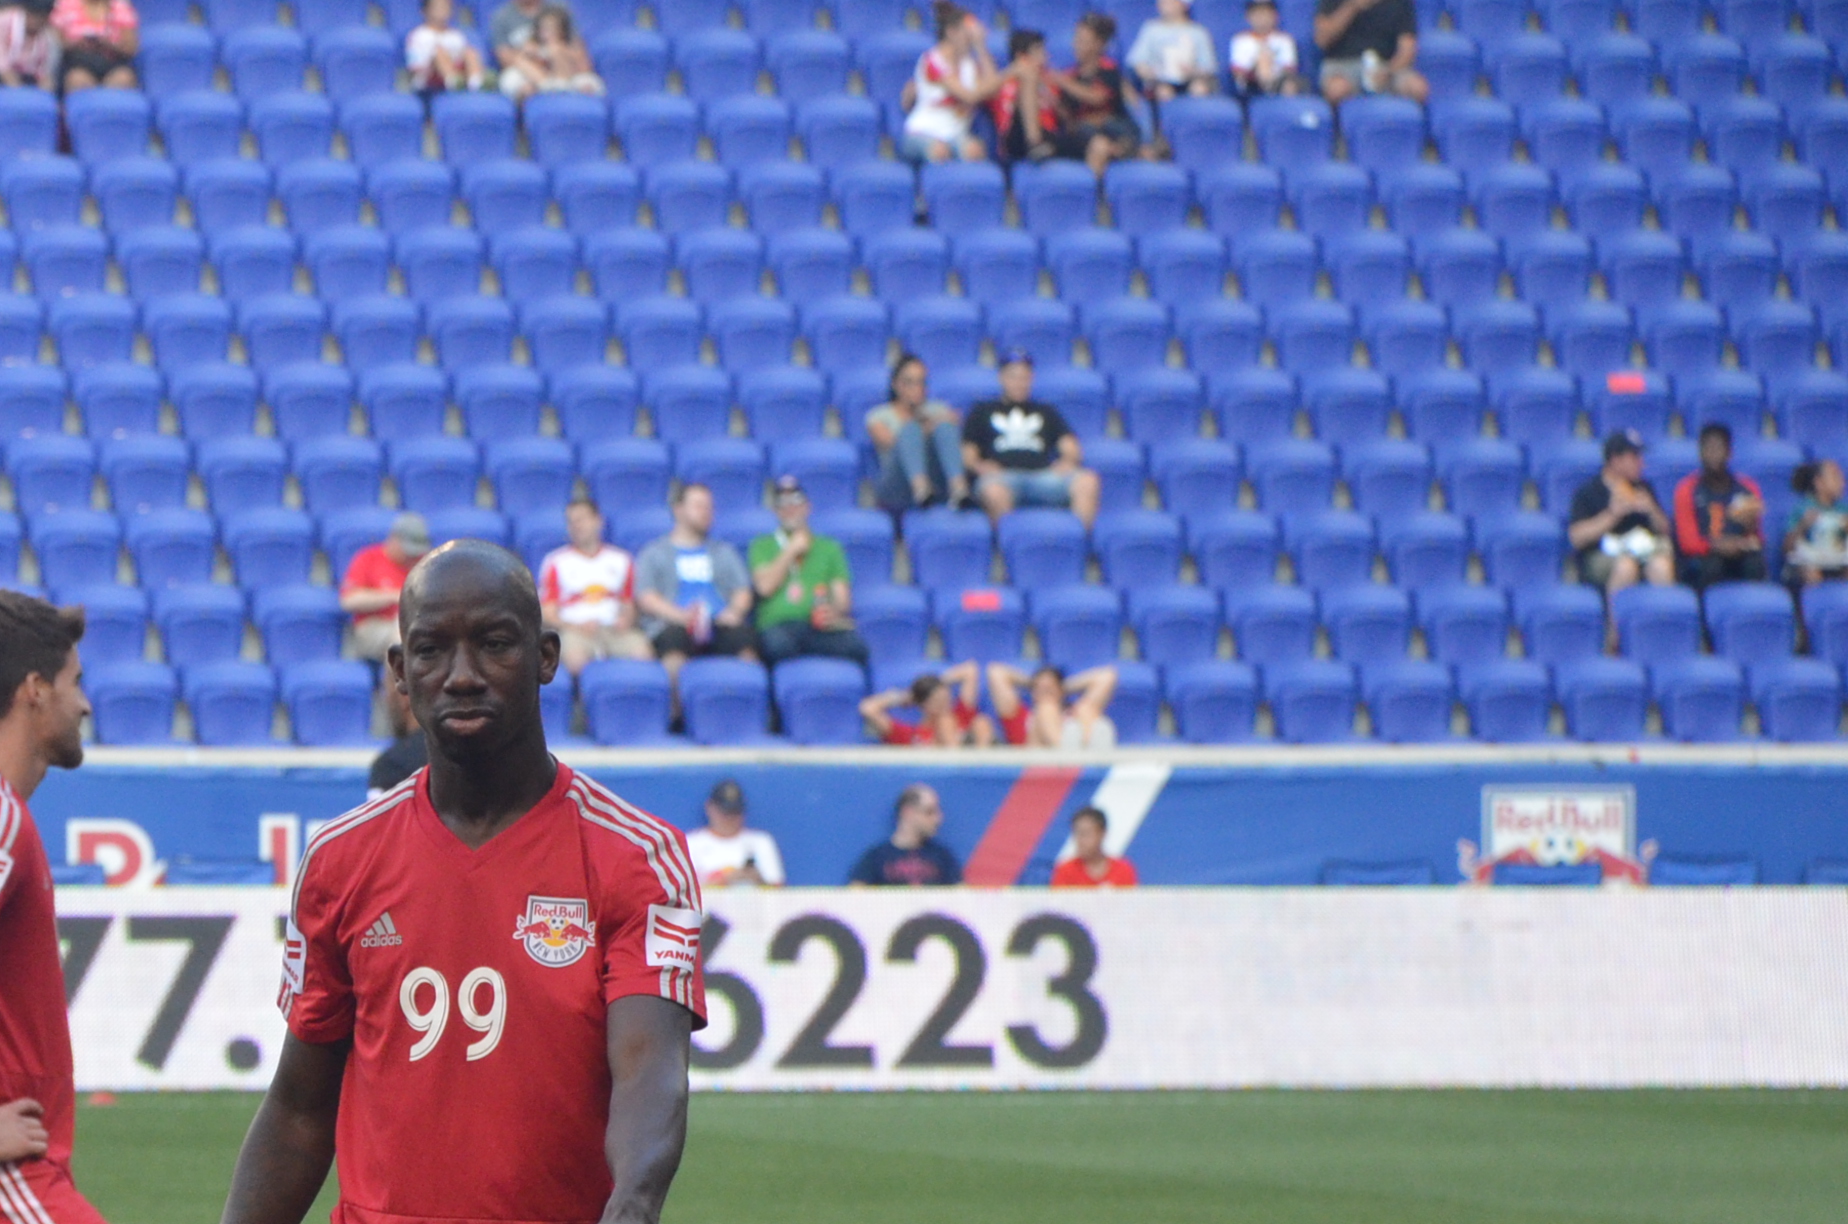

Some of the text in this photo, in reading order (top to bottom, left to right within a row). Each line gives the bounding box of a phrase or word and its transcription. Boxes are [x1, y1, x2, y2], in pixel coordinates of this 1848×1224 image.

[534, 903, 583, 919] Red Bull
[360, 934, 403, 948] adidas
[532, 940, 579, 961] NEW YORK
[654, 949, 695, 963] YANM
[399, 966, 507, 1062] 99
